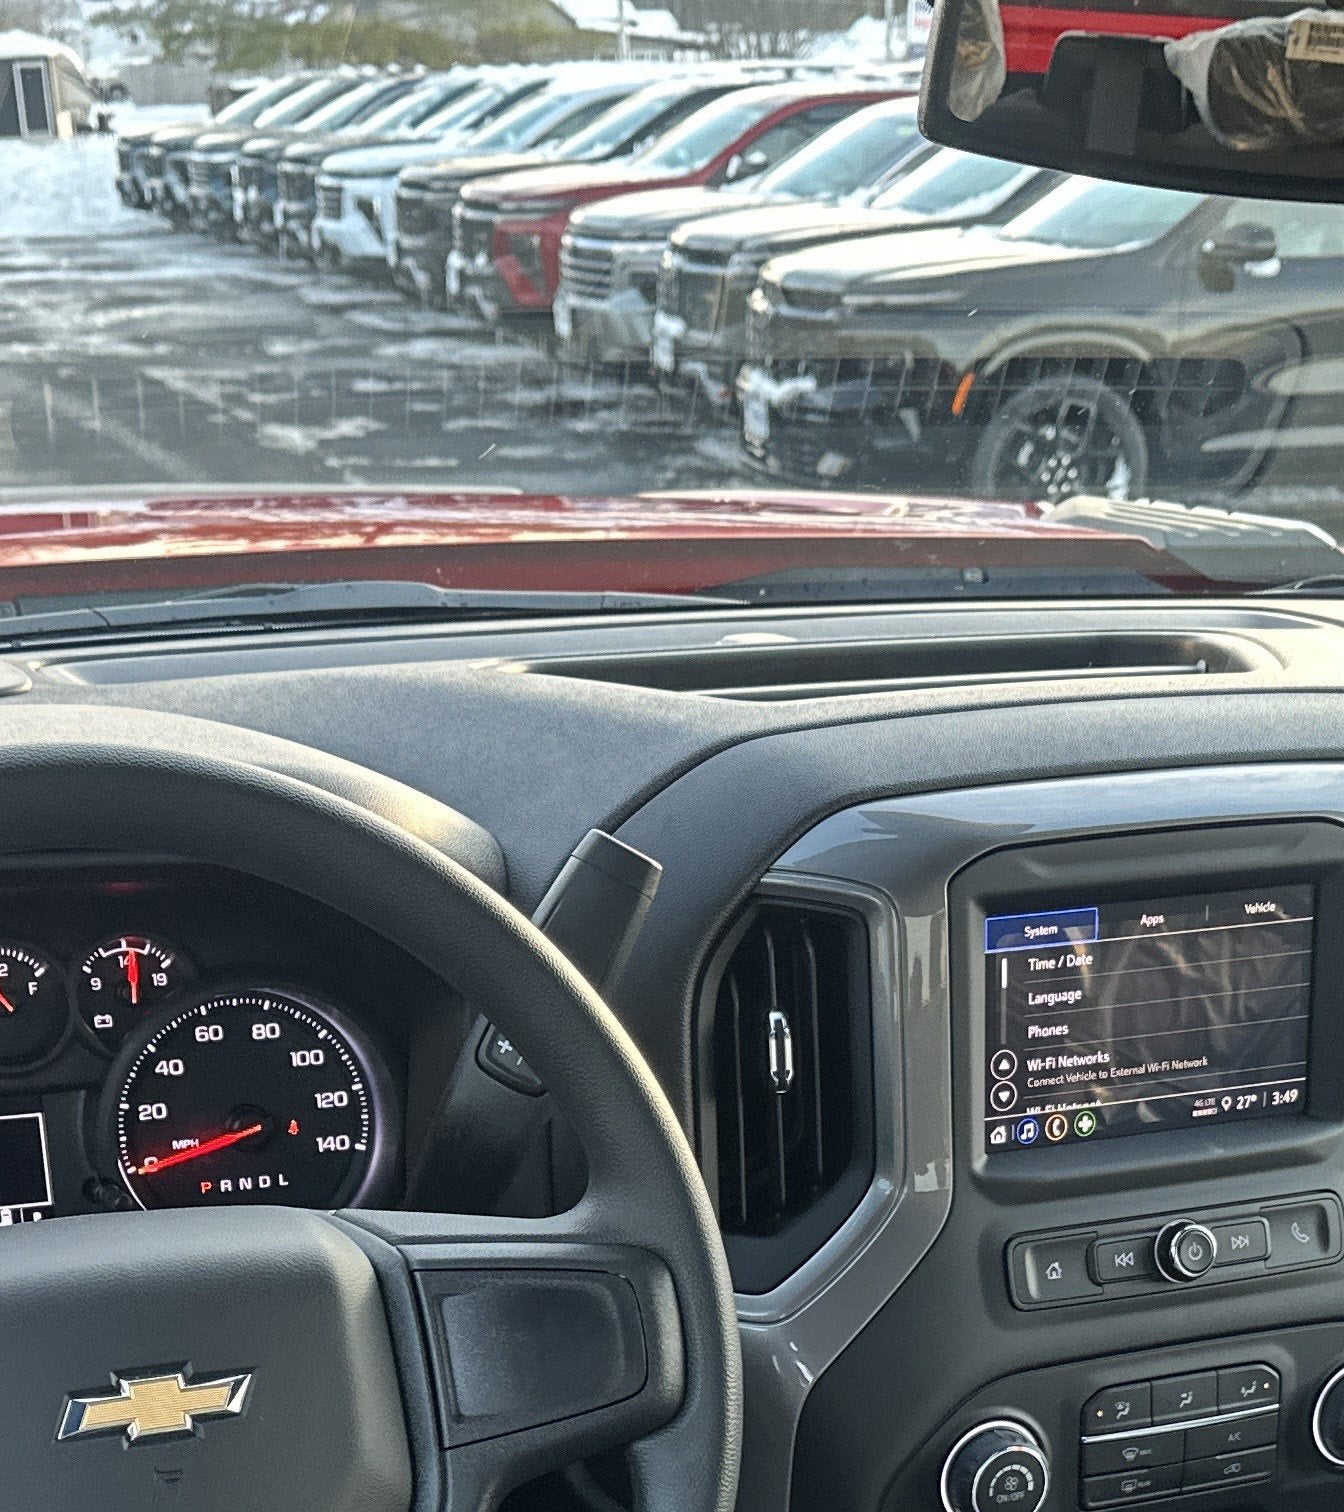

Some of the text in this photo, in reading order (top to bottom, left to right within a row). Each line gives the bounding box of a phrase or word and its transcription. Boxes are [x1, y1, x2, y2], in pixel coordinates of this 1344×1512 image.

[1244, 900, 1276, 914] Vehicle
[1140, 913, 1164, 927] Apps
[1024, 925, 1058, 939] System
[1028, 954, 1093, 971] Time / Date
[90, 977, 102, 991] 9
[151, 972, 167, 987] 19
[28, 982, 38, 995] F
[1028, 990, 1082, 1005] Language
[195, 1025, 223, 1042] 60
[251, 1023, 280, 1040] 80
[1027, 1025, 1068, 1038] Phones
[290, 1049, 324, 1066] 100
[1027, 1051, 1110, 1072] Wi-Fi Networks
[155, 1059, 184, 1076] 40
[1027, 1057, 1208, 1088] Connect Vehicle to External Wi-Fi Network
[314, 1091, 348, 1108] 120
[1271, 1088, 1298, 1105] 3:49
[138, 1103, 167, 1121] 20
[172, 1138, 199, 1150] MPH
[316, 1135, 350, 1152] 140
[201, 1174, 289, 1194] P R N D L
[996, 1490, 1025, 1504] ON/OFF
